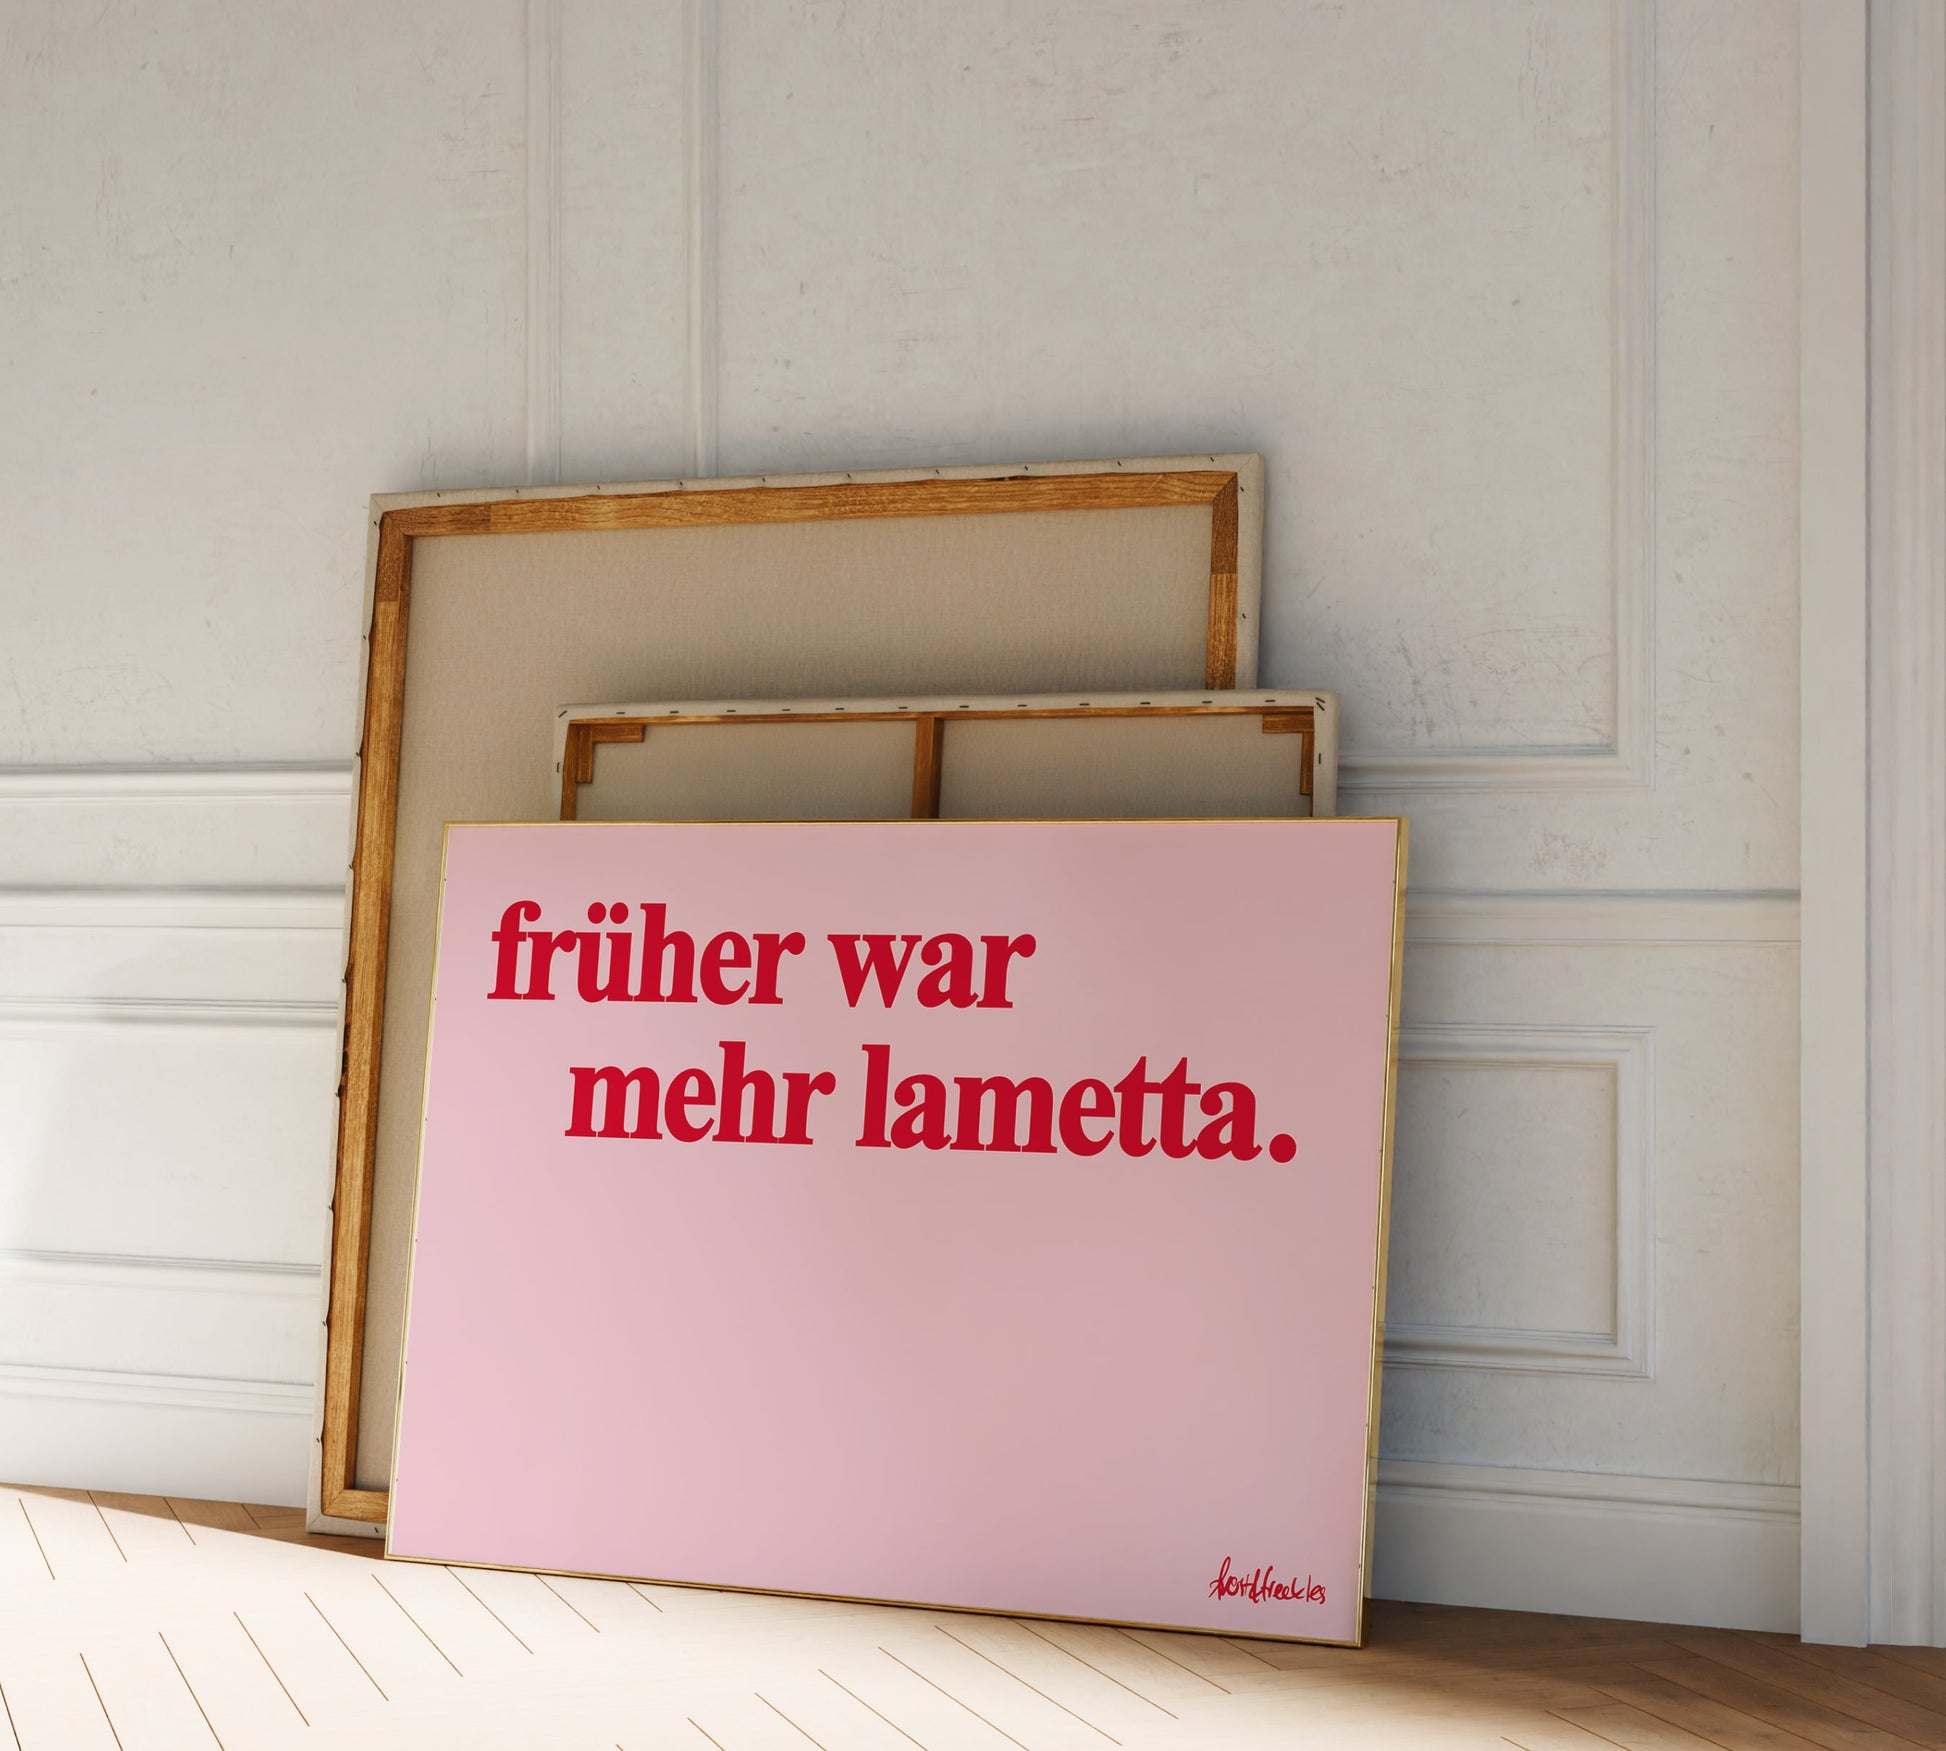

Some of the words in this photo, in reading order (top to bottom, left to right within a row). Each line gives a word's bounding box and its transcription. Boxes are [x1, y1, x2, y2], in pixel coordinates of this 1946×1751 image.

[487, 900, 807, 1005] früher
[827, 933, 1037, 1009] war
[564, 1041, 837, 1146] mehr
[855, 1044, 1297, 1164] lametta.
